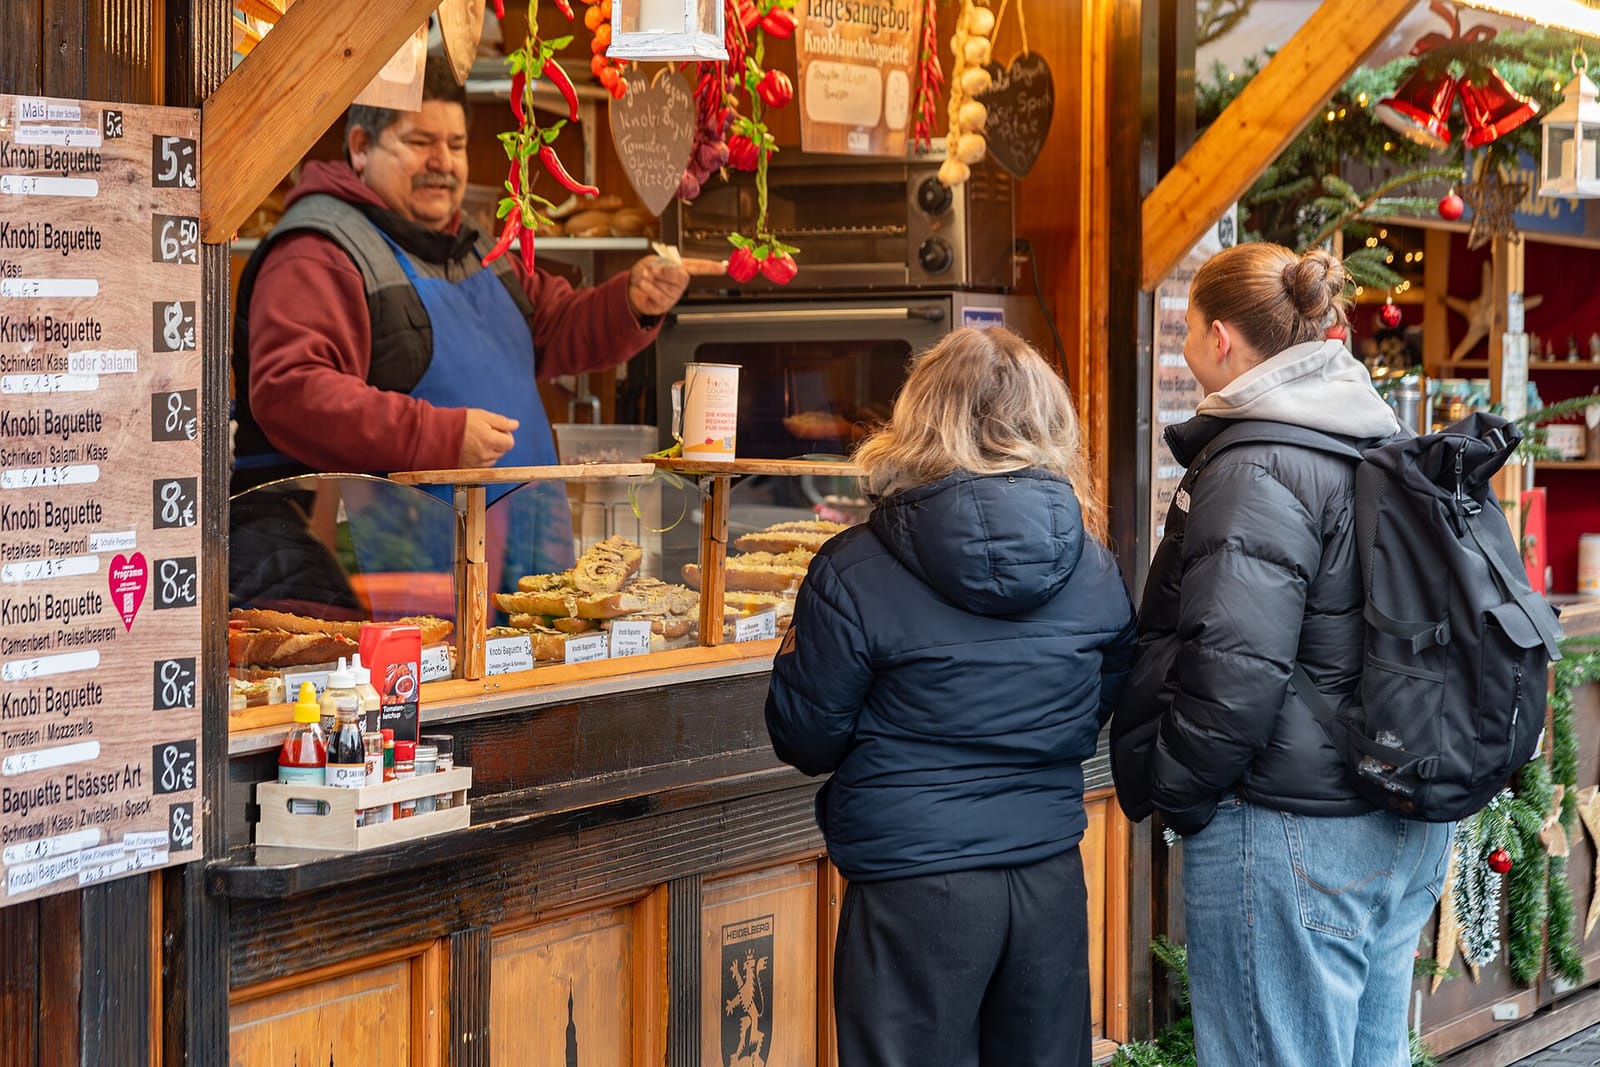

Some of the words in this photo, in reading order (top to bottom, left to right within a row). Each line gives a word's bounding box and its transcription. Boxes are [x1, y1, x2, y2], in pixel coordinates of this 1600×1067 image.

[22, 102, 45, 118] Mais
[0, 141, 40, 171] Knobi
[44, 144, 102, 177] Baguette
[0, 222, 40, 249] Knobi
[44, 223, 102, 256] Baguette
[0, 260, 23, 278] Käse
[1, 314, 40, 342] Knobi
[44, 315, 102, 348] Baguette
[72, 355, 96, 371] oder
[100, 353, 137, 371] Salami
[1, 409, 40, 437] Knobi
[44, 408, 102, 440] Baguette
[1, 446, 42, 467] Schinken
[50, 444, 80, 463] Salami
[86, 443, 108, 461] Käse
[1, 501, 41, 531] Knobi
[45, 500, 102, 533] Baguette
[1, 540, 41, 560] Fetakäse
[48, 536, 88, 558] Peperoni
[113, 568, 143, 581] Programm
[1, 595, 41, 626] Knobi
[45, 592, 103, 625] Baguette
[57, 626, 117, 648] Preiselbeeren
[489, 646, 502, 656] Knobi
[503, 645, 522, 656] Baguette
[2, 687, 41, 720] Knobi
[45, 682, 103, 716] Baguette
[2, 729, 41, 749] Tomaten
[48, 717, 94, 741] Mozzarella
[3, 782, 61, 817] Baguette
[65, 773, 120, 800] Elsässer
[123, 763, 142, 789] Art
[2, 819, 44, 845] Schmand
[52, 812, 74, 831] Käse
[80, 802, 119, 828] Zwiebeln
[125, 798, 151, 818] Speck
[10, 866, 37, 888] Knobi
[39, 855, 79, 880] Baguette
[726, 922, 770, 941] HEIDELBERG
